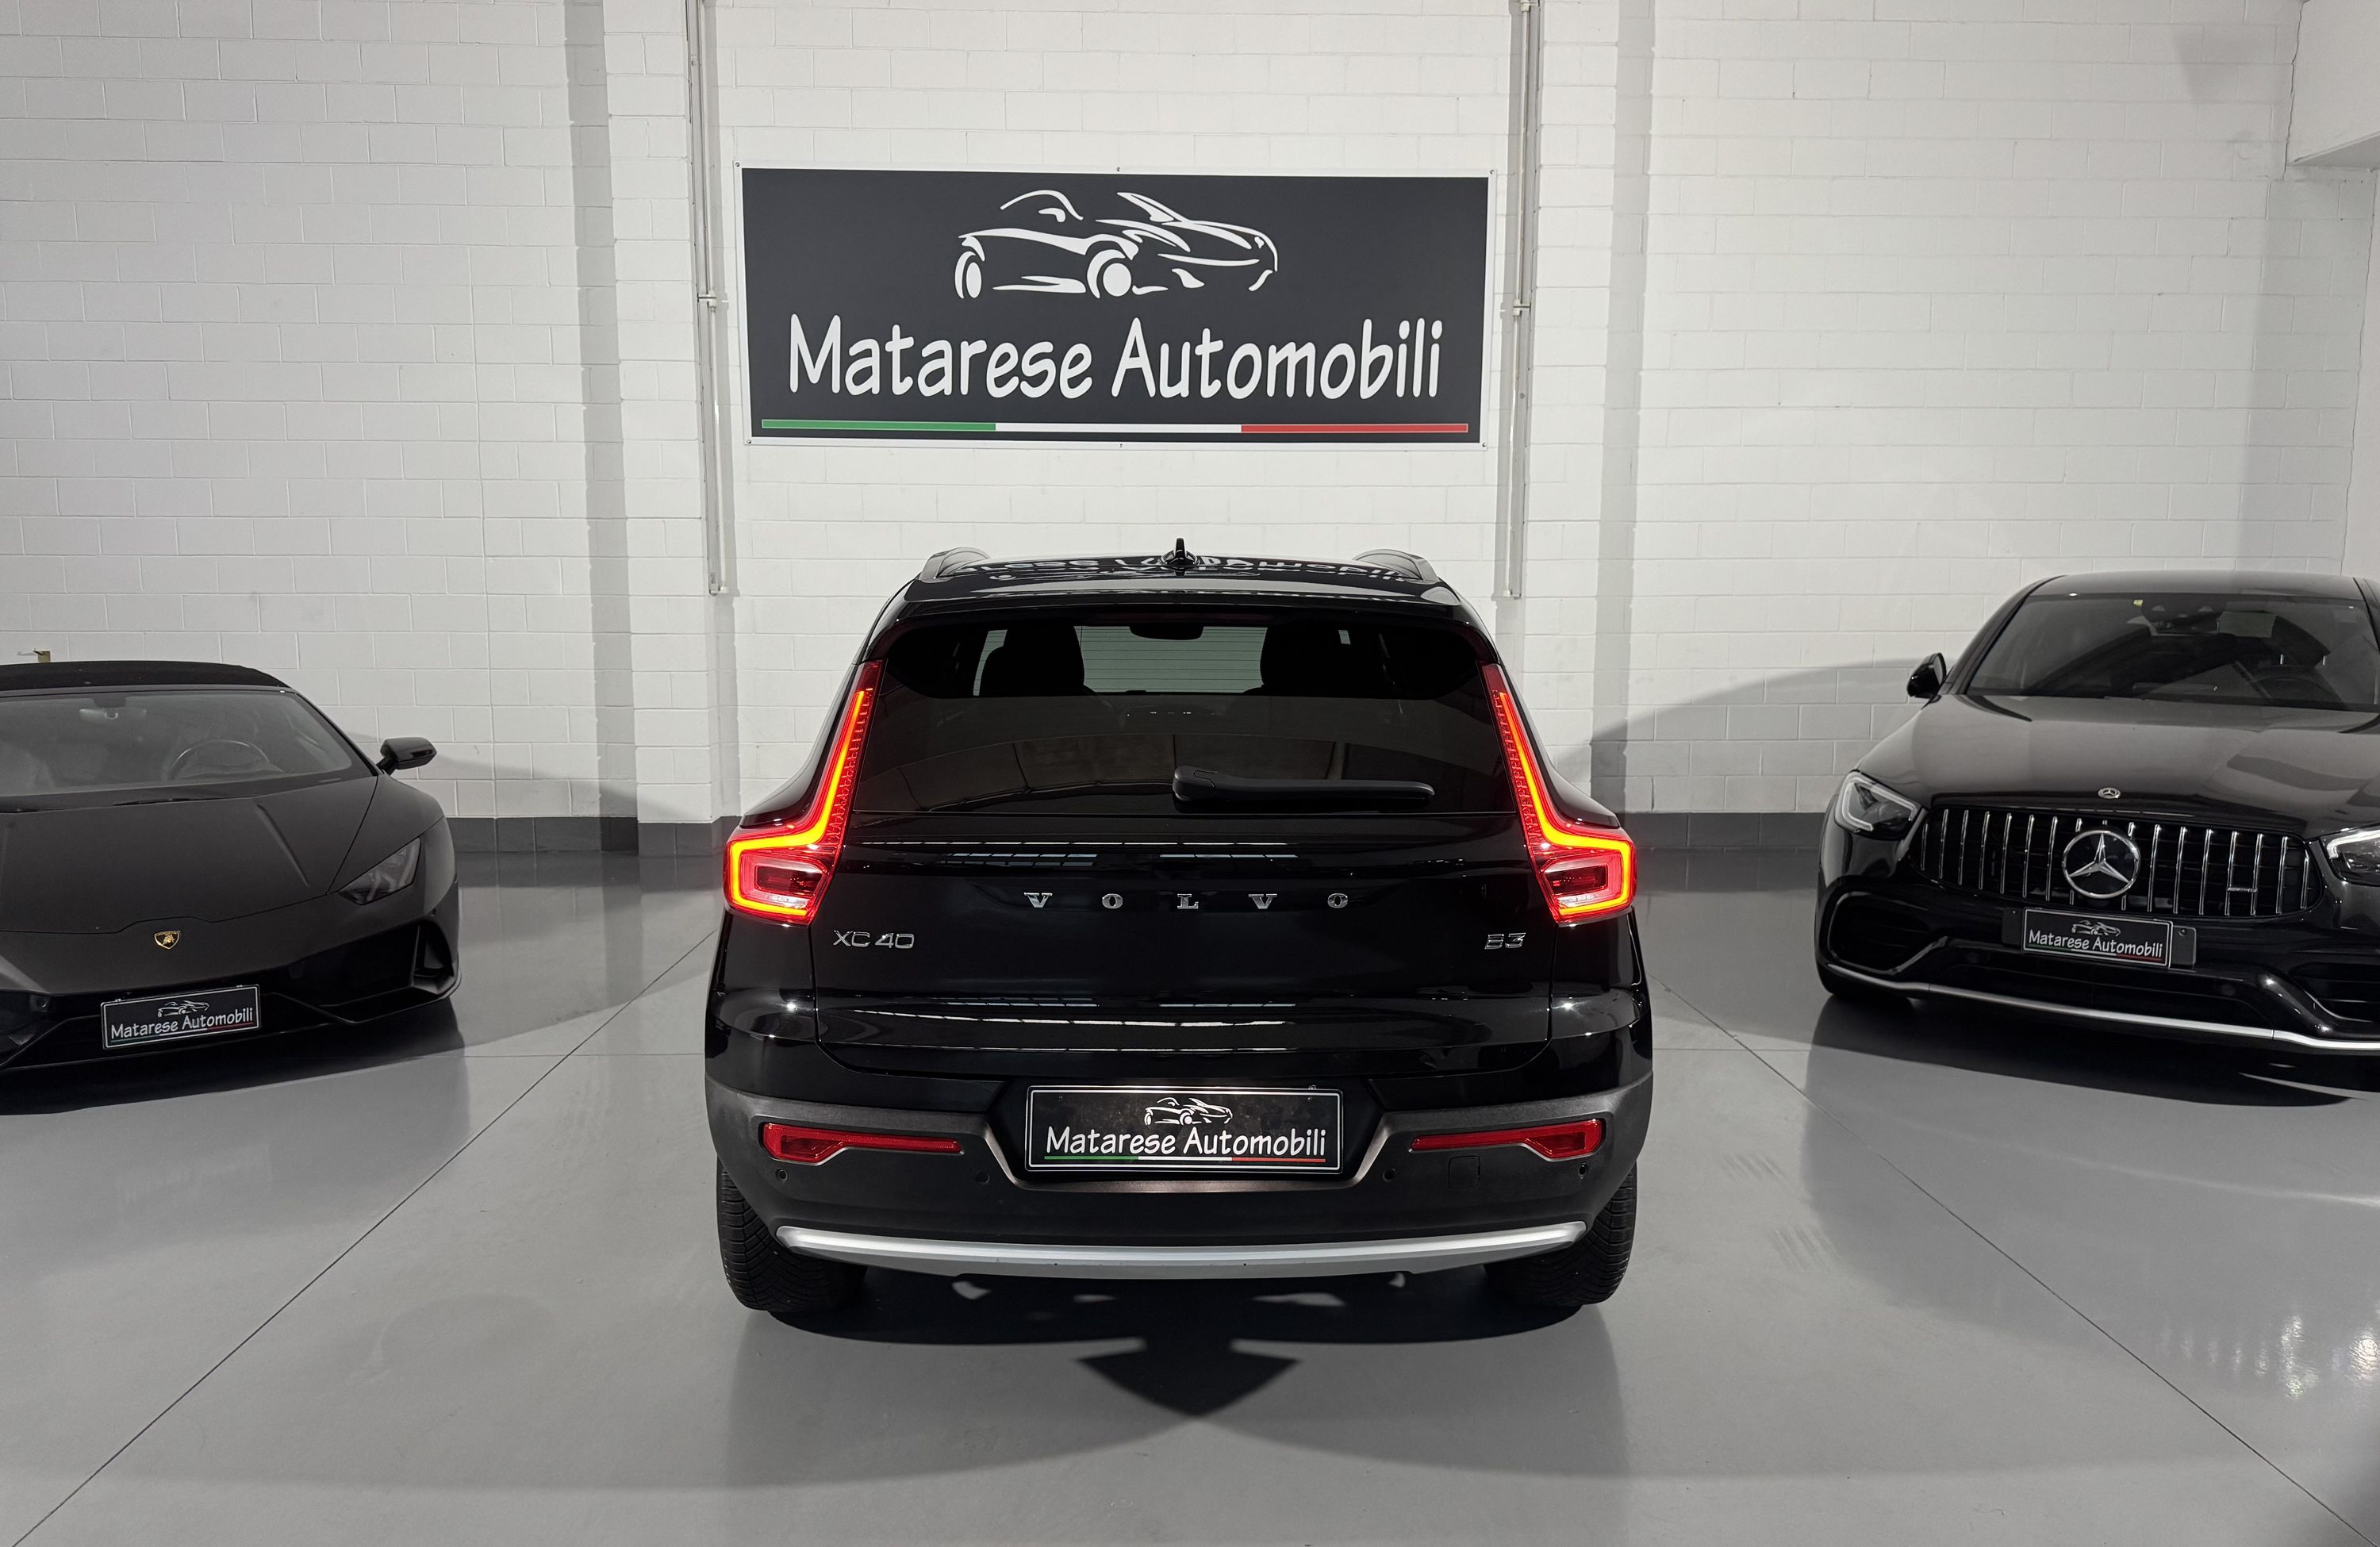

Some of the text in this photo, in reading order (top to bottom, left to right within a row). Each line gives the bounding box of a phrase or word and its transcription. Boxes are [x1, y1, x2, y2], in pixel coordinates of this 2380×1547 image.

[789, 313, 1443, 399] Matarese Automobili
[1023, 892, 1349, 910] VOLVO
[1484, 932, 1526, 950] B3
[2029, 929, 2163, 958] Matarese Automobili
[111, 1008, 253, 1039] Matarese Automobili
[1046, 1126, 1326, 1157] Matarese Automobili
